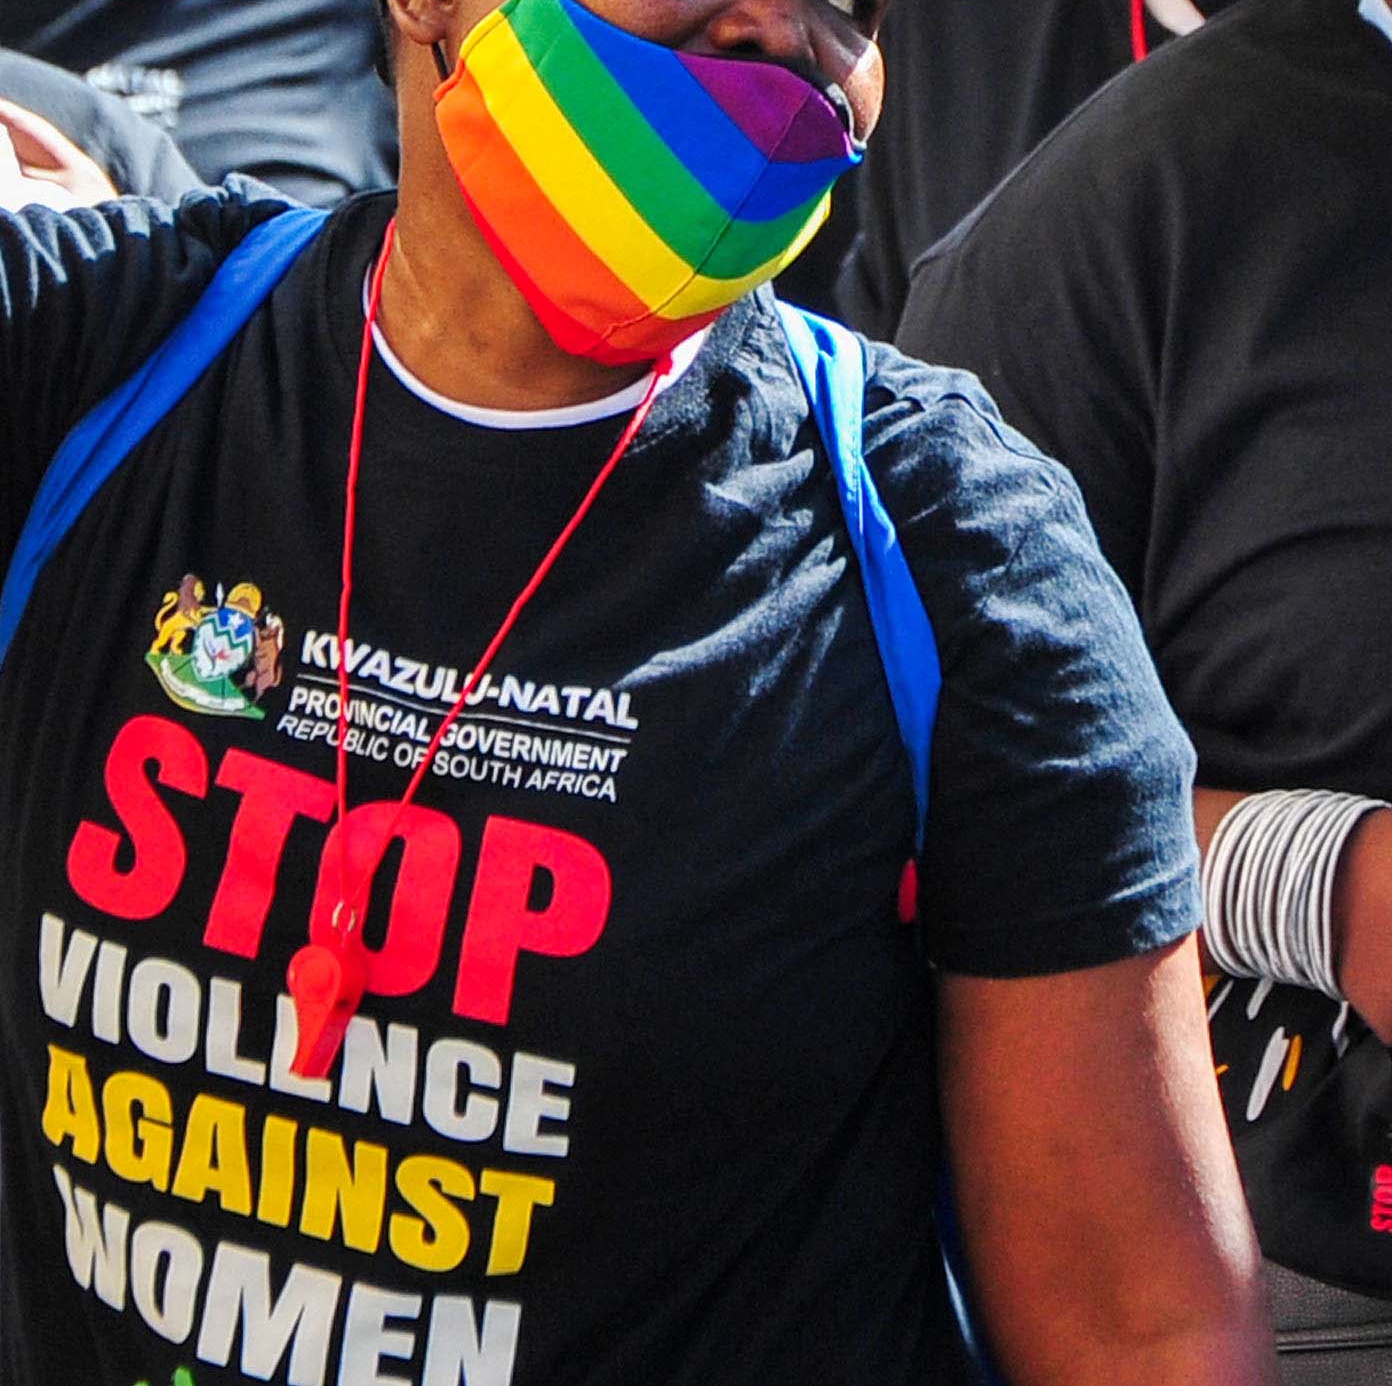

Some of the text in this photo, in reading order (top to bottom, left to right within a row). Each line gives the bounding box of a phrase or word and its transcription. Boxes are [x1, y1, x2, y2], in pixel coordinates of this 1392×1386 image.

[276, 713, 617, 804] REPUBLIC OF SOUTH AFRICA
[288, 686, 629, 774] PROVINCIAL GOVERNMENT
[300, 629, 640, 731] KWAZULU-NATAL
[66, 714, 612, 1026] STOP
[38, 913, 576, 1157] VIOLENCE
[42, 1043, 555, 1276] AGAINST
[53, 1164, 522, 1386] WOMEN
